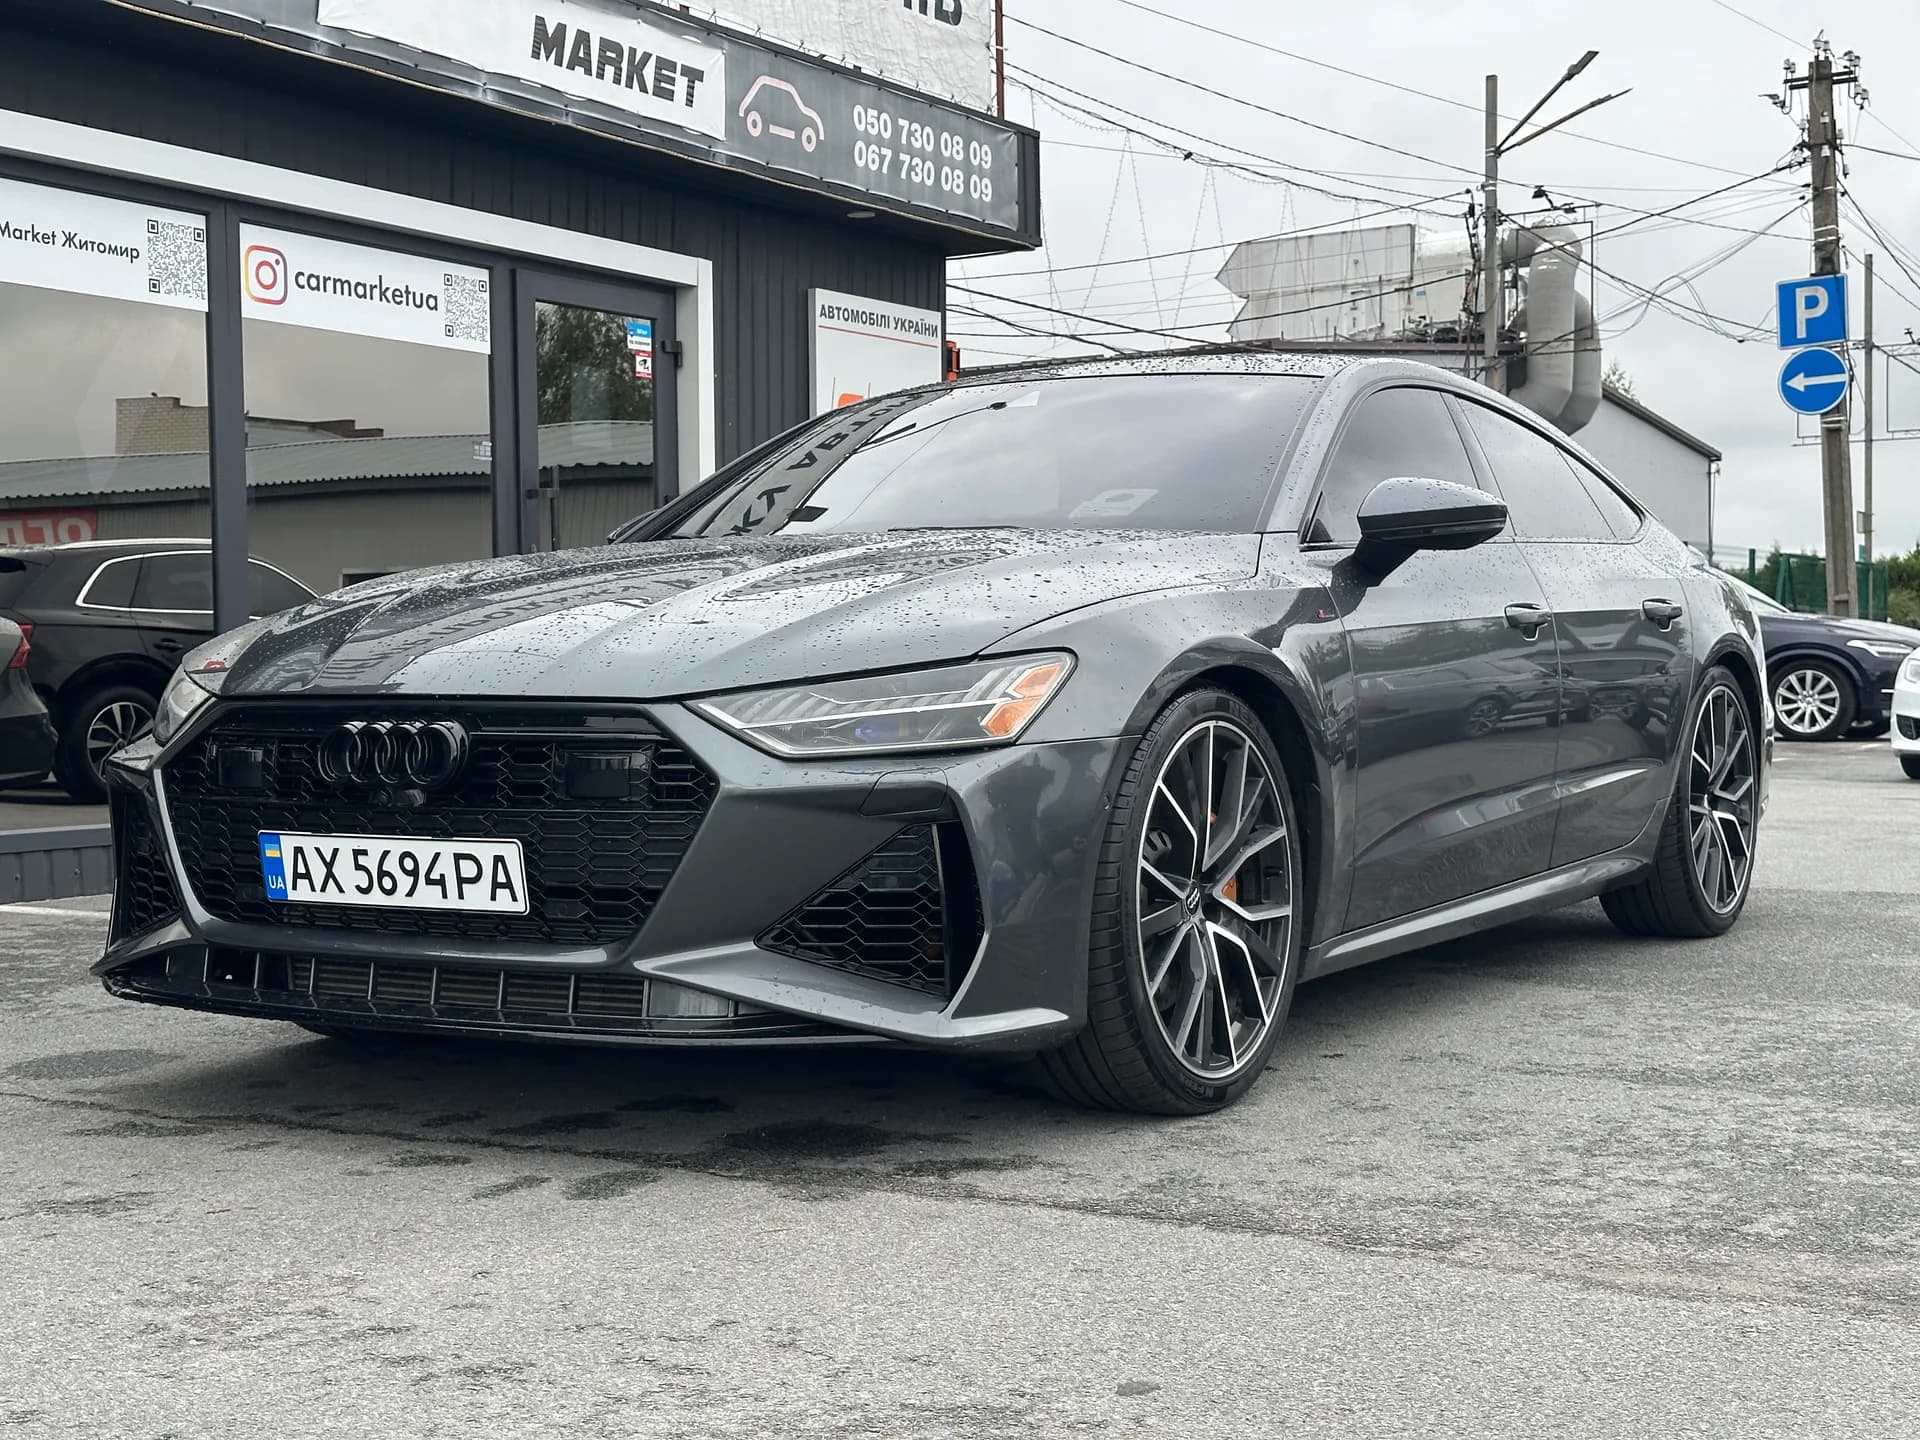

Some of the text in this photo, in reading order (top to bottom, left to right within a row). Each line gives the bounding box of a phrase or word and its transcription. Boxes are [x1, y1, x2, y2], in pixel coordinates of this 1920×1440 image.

[530, 14, 705, 108] MARKET
[853, 104, 992, 169] 050 730 08 09
[854, 140, 992, 203] 067 730 08 09
[0, 220, 140, 264] Market Житомир
[294, 268, 440, 312] carmarketua
[1795, 286, 1829, 339] P
[818, 303, 939, 339] АВТОМОБІЛІ УКРАЇНИ
[268, 875, 285, 890] UA
